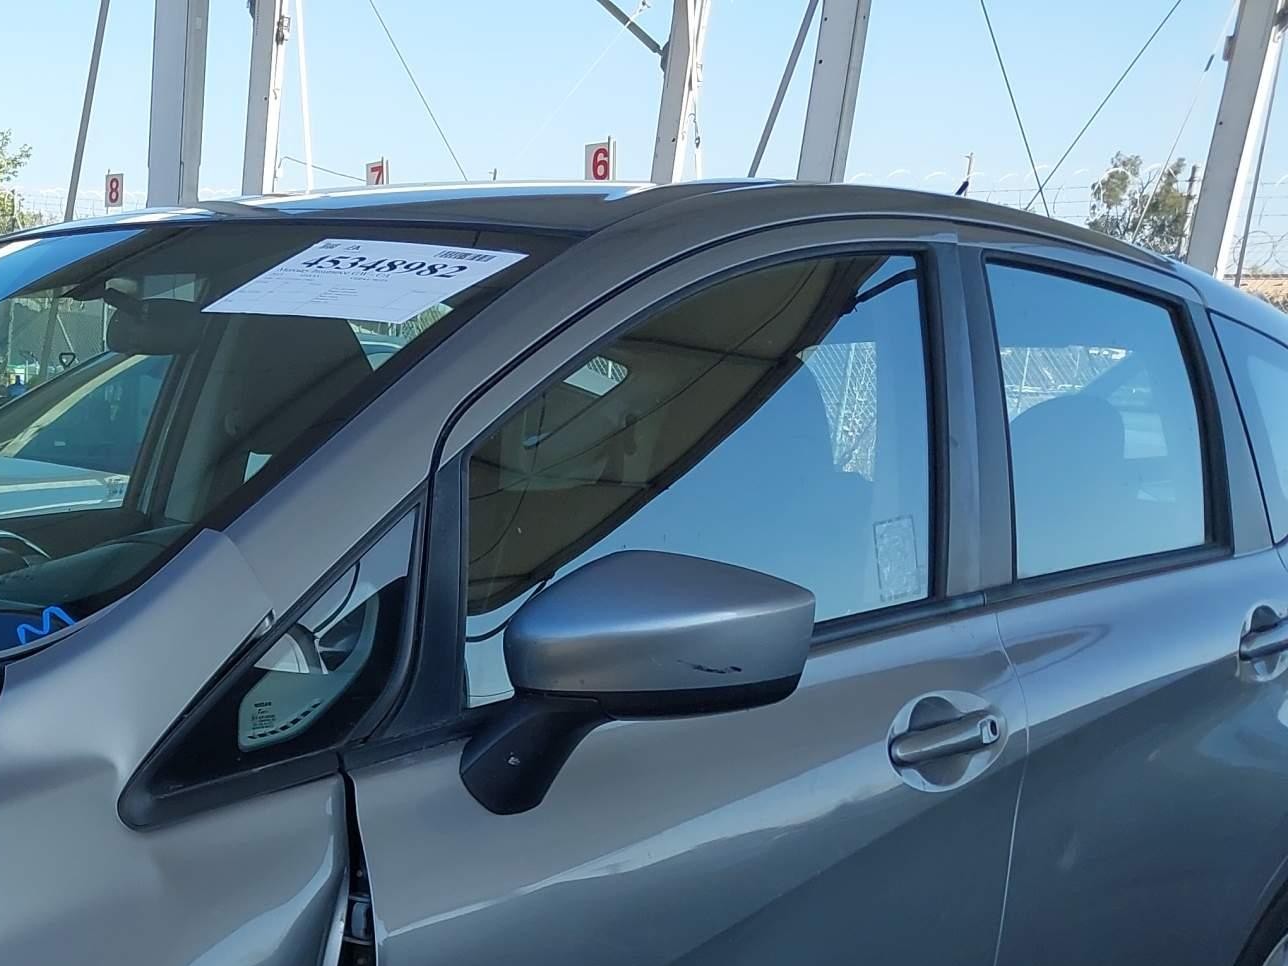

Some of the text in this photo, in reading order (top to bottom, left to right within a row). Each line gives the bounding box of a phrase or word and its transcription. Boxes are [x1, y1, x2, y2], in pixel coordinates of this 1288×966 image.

[370, 165, 383, 185] 7
[592, 147, 609, 181] 6
[108, 177, 120, 204] 8
[302, 255, 467, 279] 45348982
